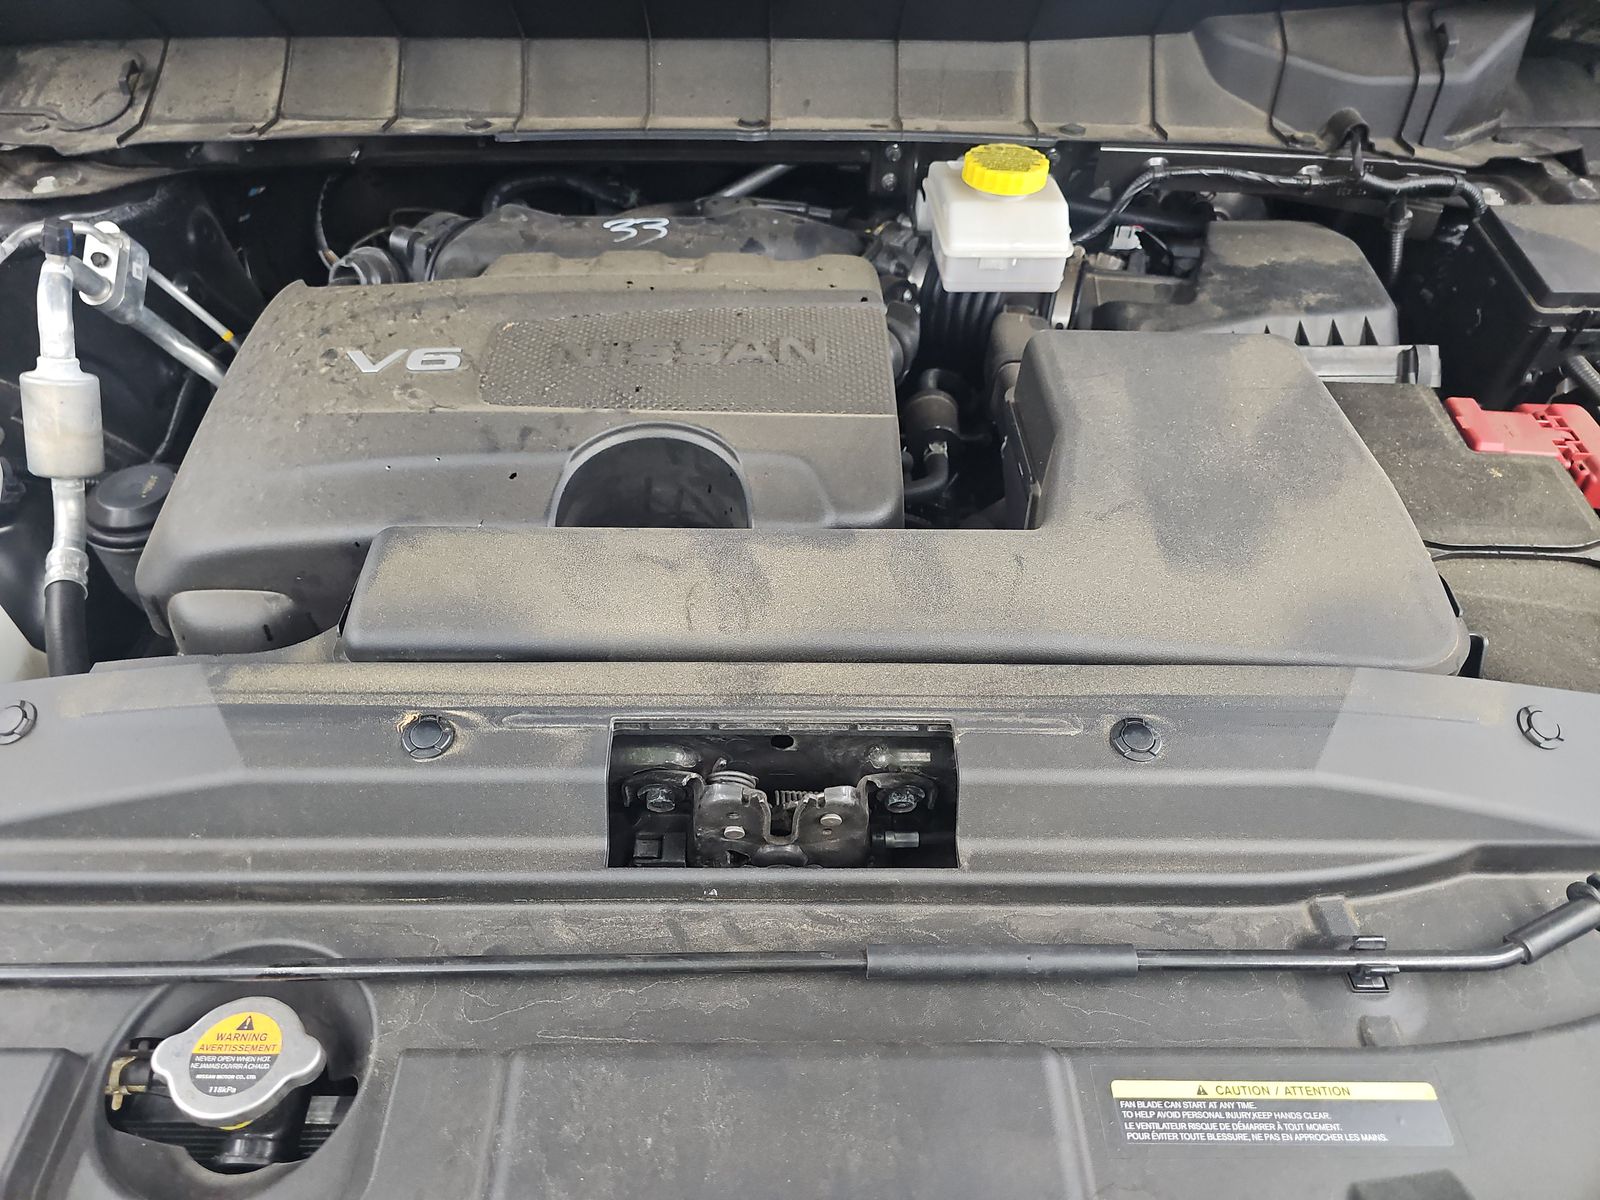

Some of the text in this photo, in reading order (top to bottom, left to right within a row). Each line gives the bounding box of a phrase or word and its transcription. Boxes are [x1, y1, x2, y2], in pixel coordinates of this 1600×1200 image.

[603, 218, 669, 246] 33
[346, 347, 463, 373] V6
[216, 1033, 268, 1041] WARNING
[199, 1044, 277, 1052] AVERTISSEMENT
[1215, 1085, 1270, 1096] CAUTION
[1284, 1086, 1351, 1096] ATTENTION
[1136, 1101, 1163, 1109] BLADE
[1164, 1101, 1182, 1109] CAN
[1182, 1101, 1206, 1109] START
[1208, 1101, 1217, 1109] AT
[1219, 1101, 1235, 1109] ANY
[1182, 1111, 1224, 1119] PERSONAL
[1274, 1112, 1302, 1120] HANDS
[1124, 1122, 1135, 1130] LE
[1136, 1122, 1187, 1130] VENTILATEUR
[1188, 1122, 1220, 1130] RISQUE
[1220, 1122, 1232, 1130] DE
[1232, 1120, 1276, 1130] DÉMARRER
[1283, 1122, 1304, 1130] TOUT
[1152, 1130, 1179, 1140] ÉVITER
[1180, 1132, 1206, 1140] TOUTE
[1264, 1133, 1280, 1141] PAS
[1282, 1133, 1294, 1141] EN
[1294, 1133, 1344, 1142] APPROCHER
[1345, 1134, 1360, 1142] LES
